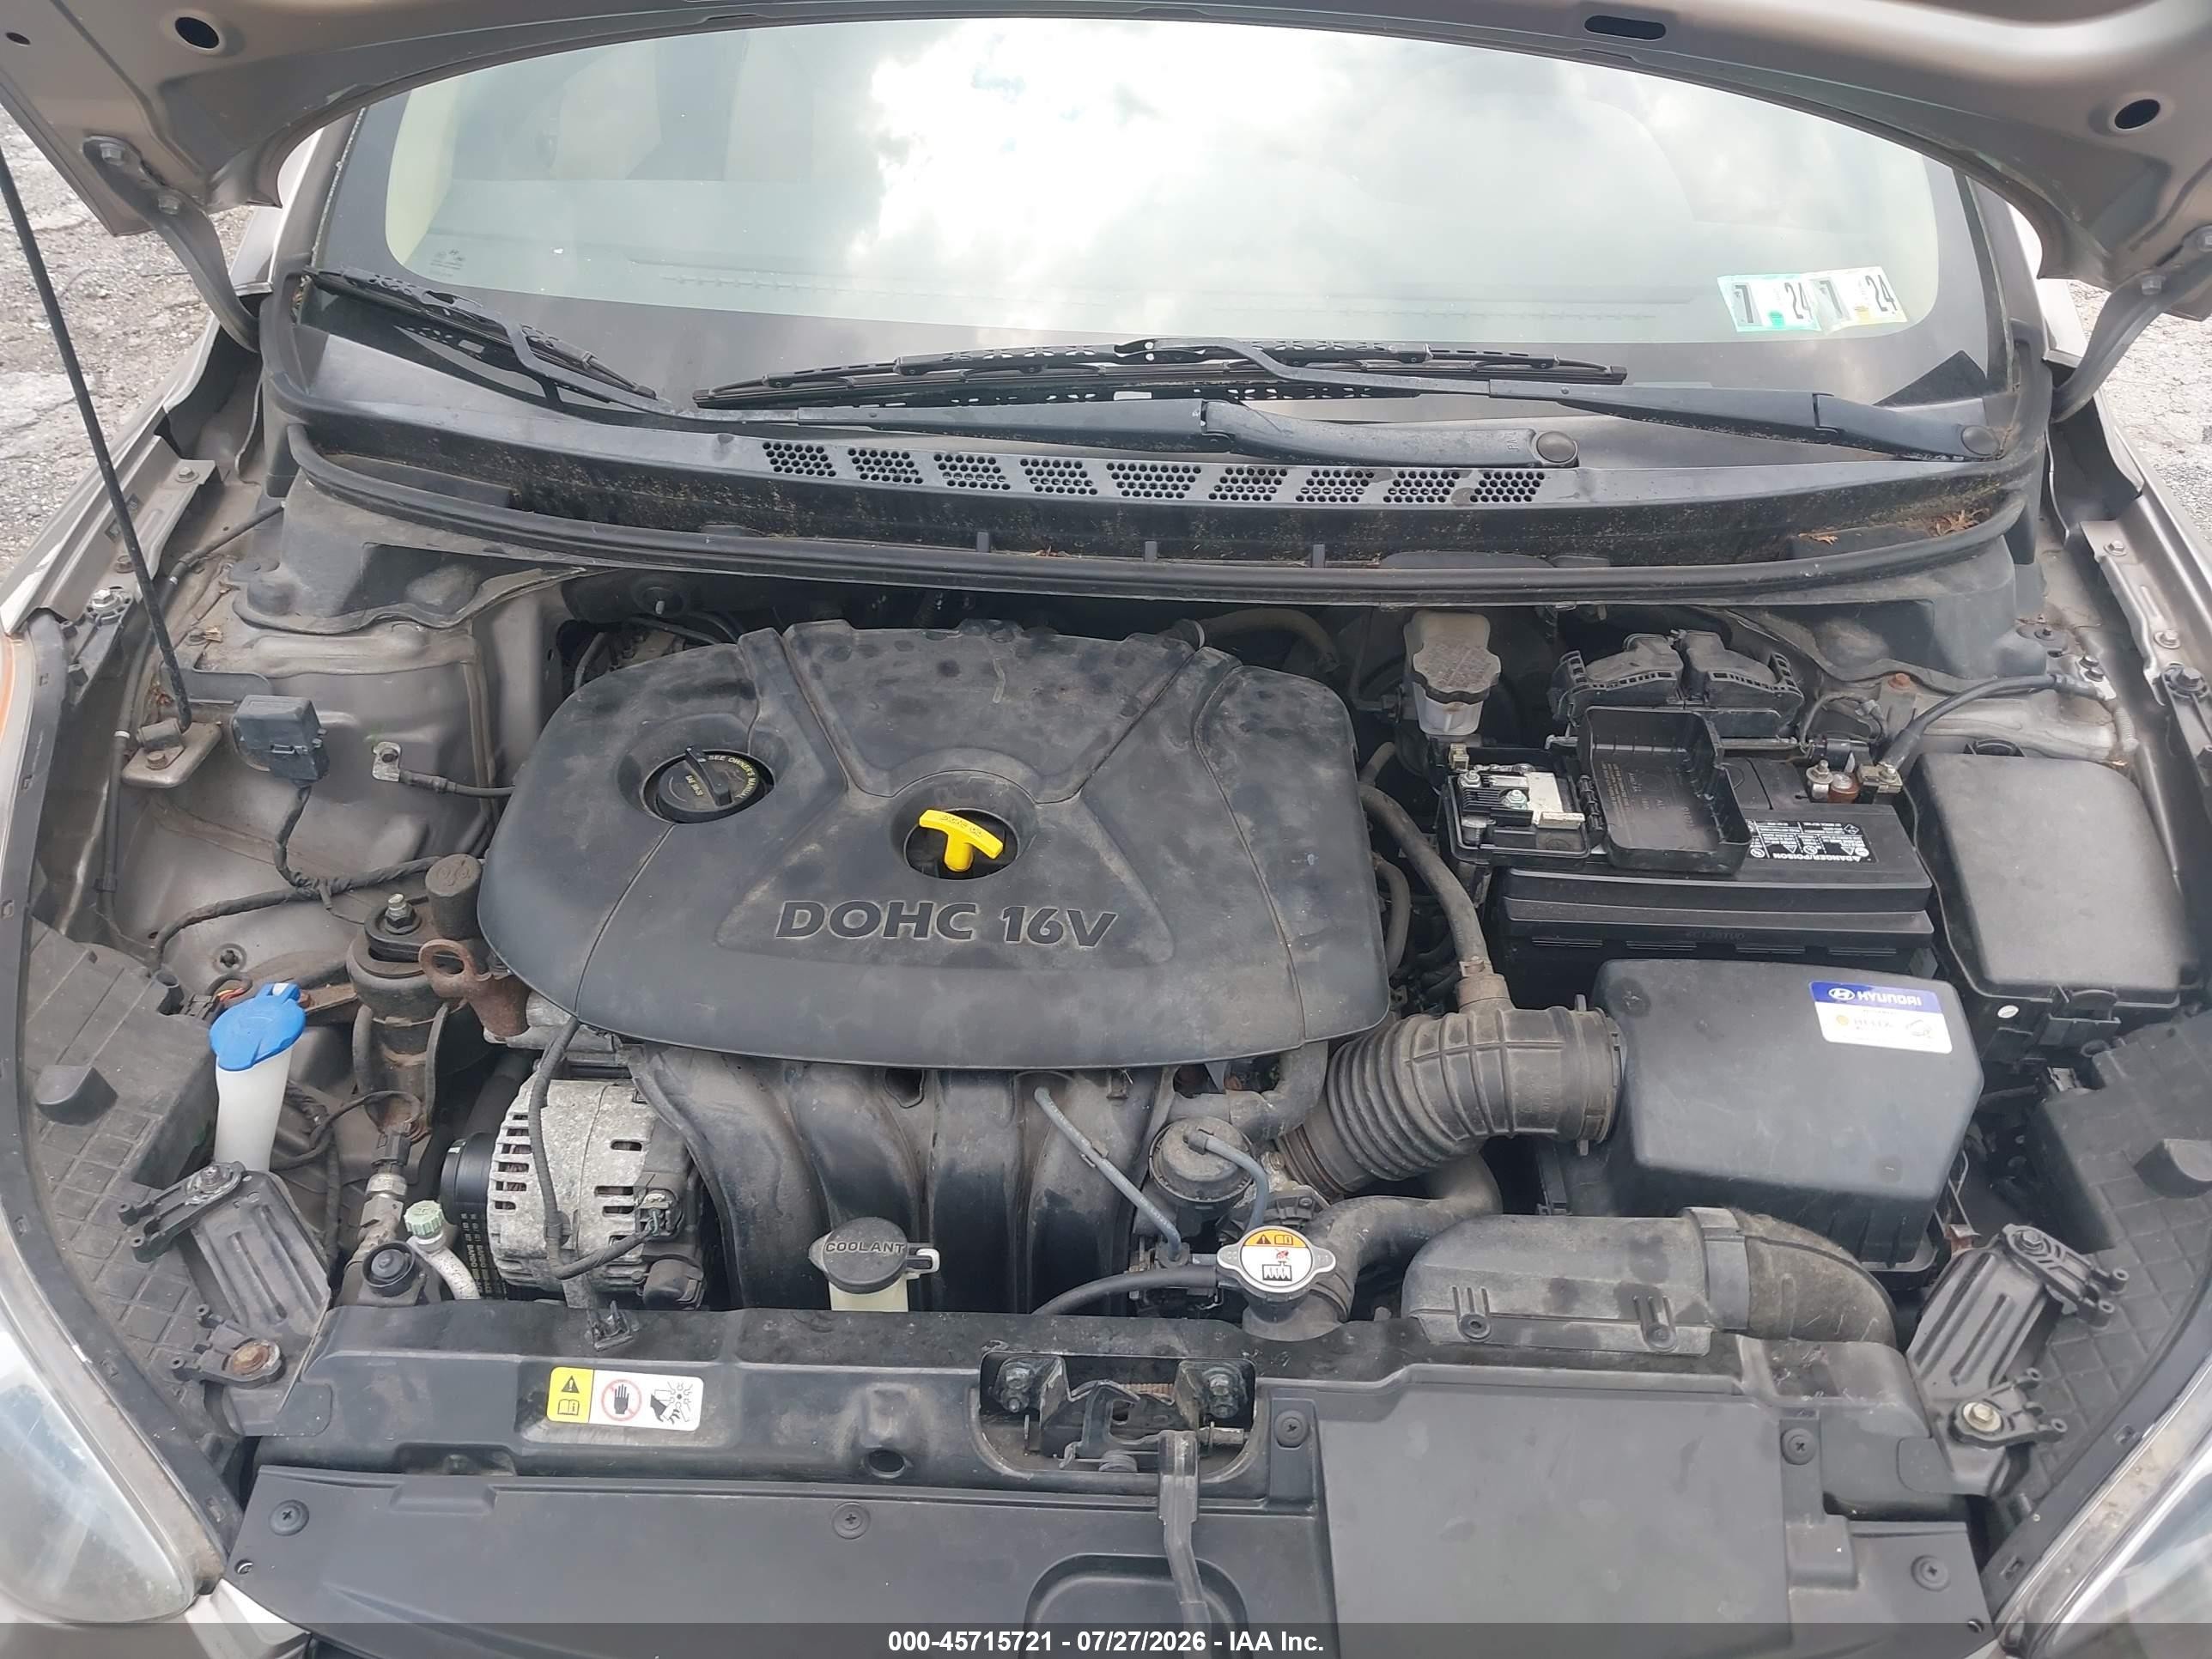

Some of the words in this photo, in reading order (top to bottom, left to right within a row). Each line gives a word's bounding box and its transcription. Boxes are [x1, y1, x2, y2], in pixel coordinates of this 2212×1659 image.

[1864, 275, 1898, 312] 24
[775, 900, 977, 940] DOHC
[1002, 905, 1118, 948] 16V
[1856, 990, 1923, 1006] HYUNDAI
[825, 1242, 905, 1254] COOLANT
